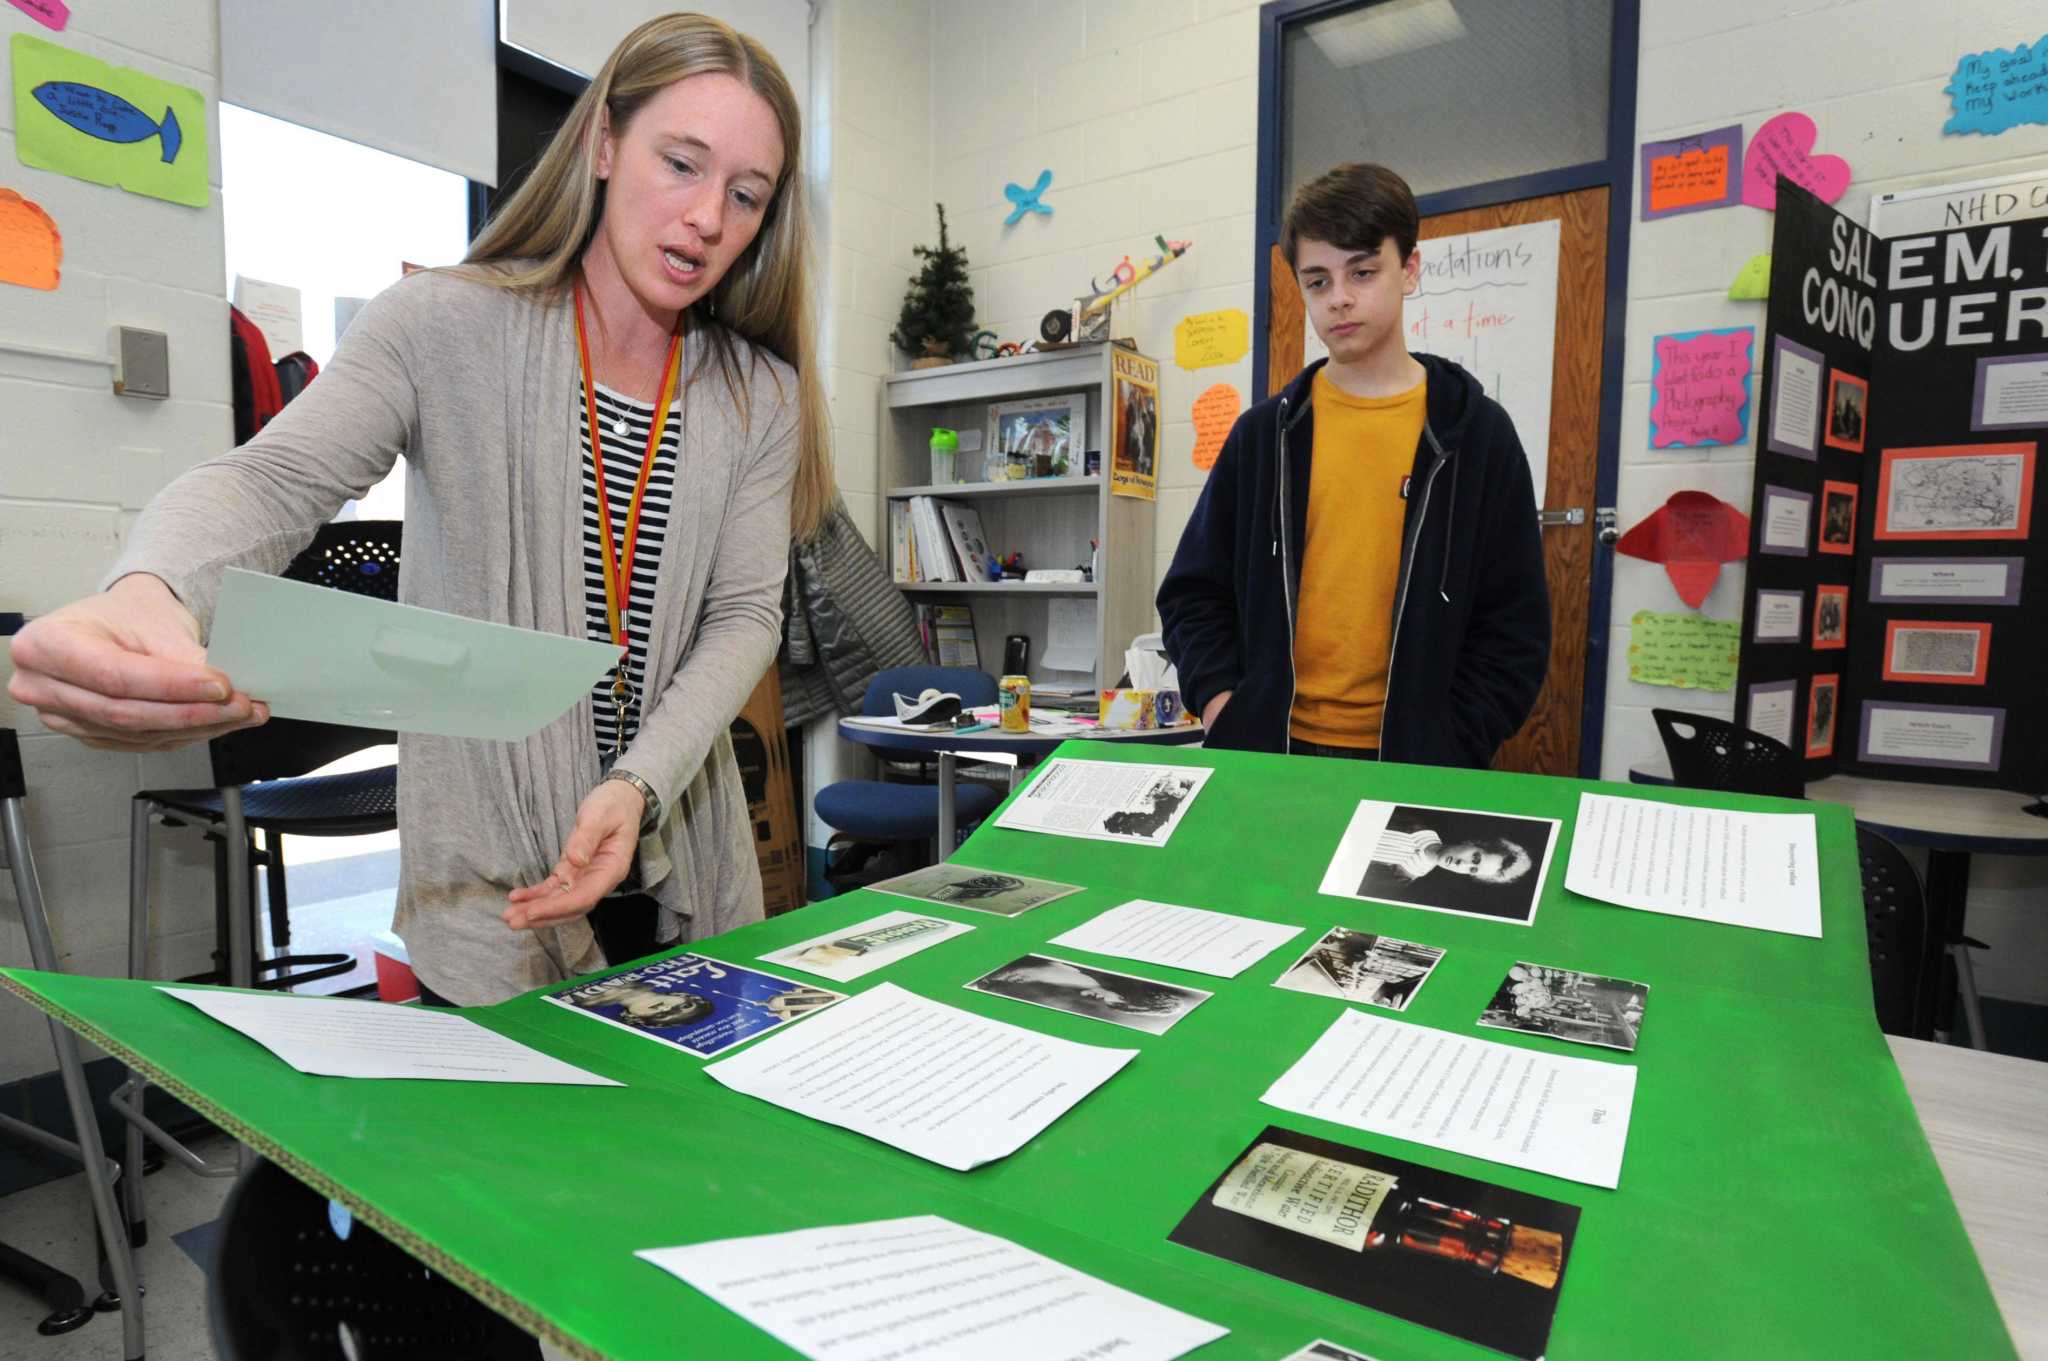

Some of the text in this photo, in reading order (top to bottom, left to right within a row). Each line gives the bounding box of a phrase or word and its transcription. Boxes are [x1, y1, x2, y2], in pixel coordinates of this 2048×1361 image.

[1945, 193, 2018, 227] NHD
[1419, 237, 1533, 296] pectations
[1116, 355, 1156, 384] READ
[560, 955, 703, 1003] THO-RADIA
[646, 960, 728, 989] Lait
[1329, 1171, 1385, 1238] RADITHOR
